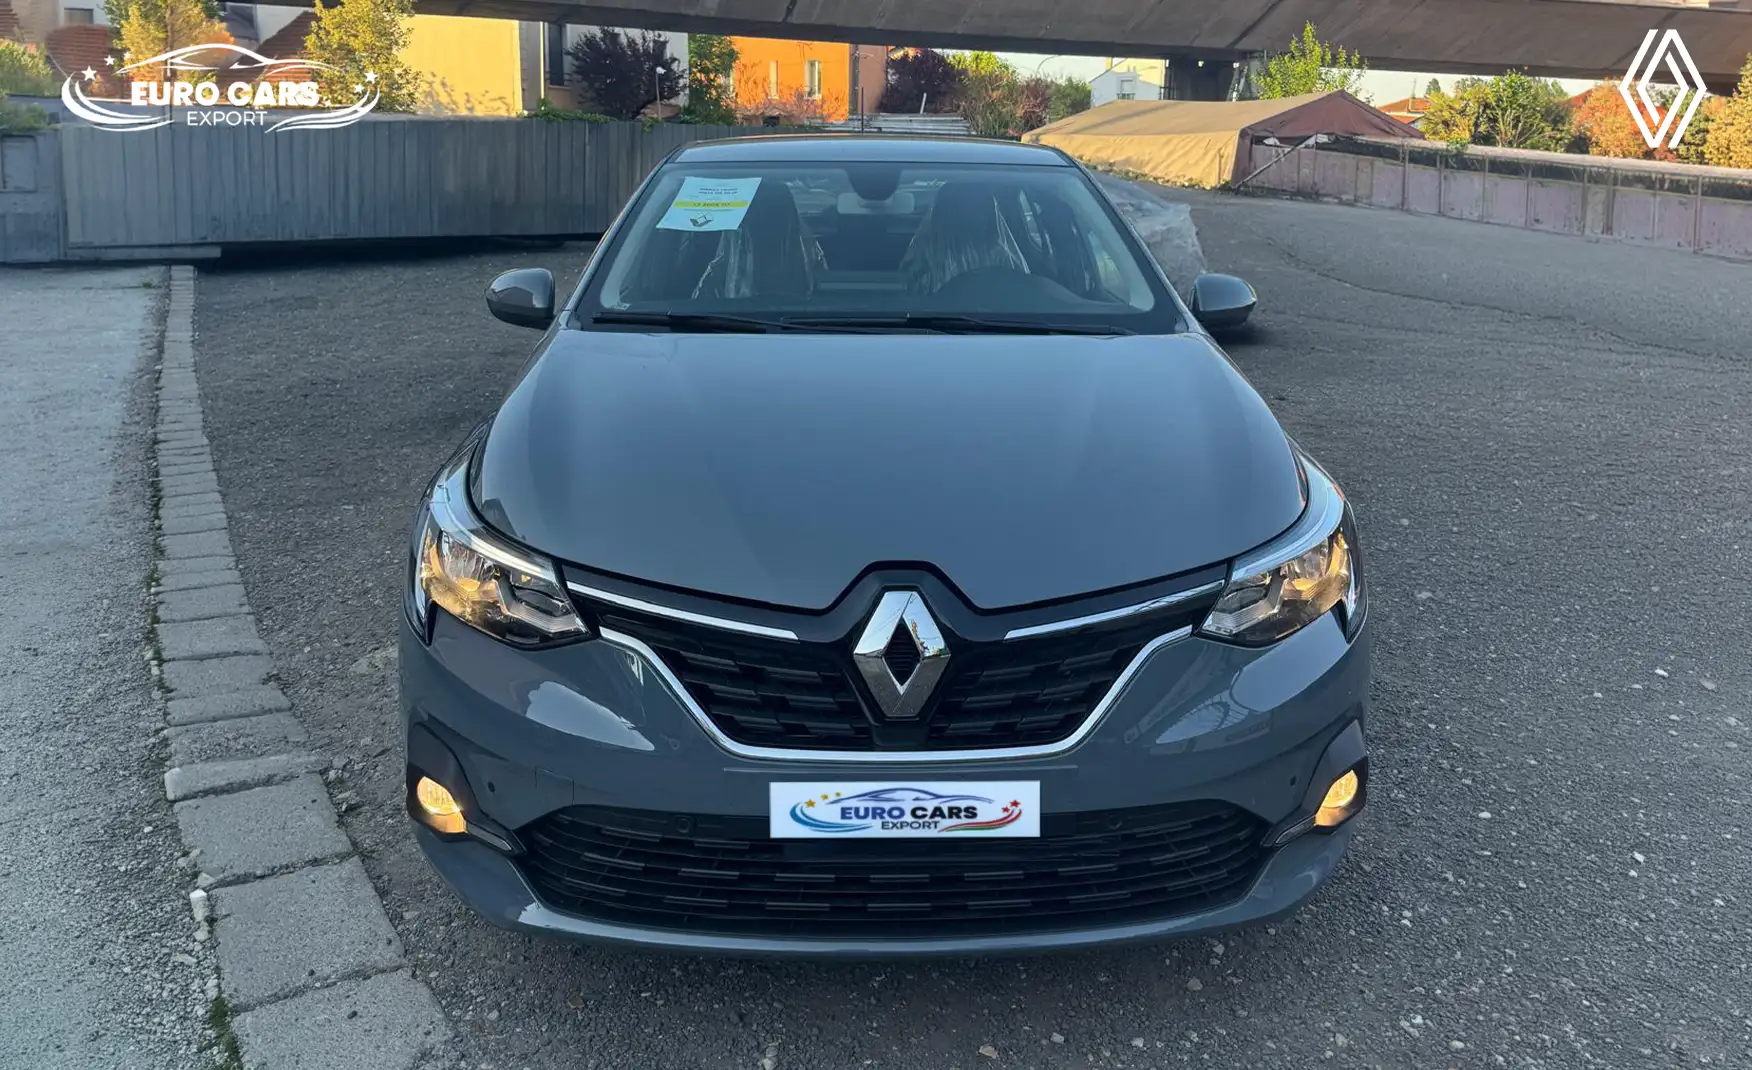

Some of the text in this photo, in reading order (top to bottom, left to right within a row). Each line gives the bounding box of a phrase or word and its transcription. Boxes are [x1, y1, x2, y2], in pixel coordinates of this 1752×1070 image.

[839, 806, 978, 820] EURO CARS
[881, 820, 941, 831] EXPORT
